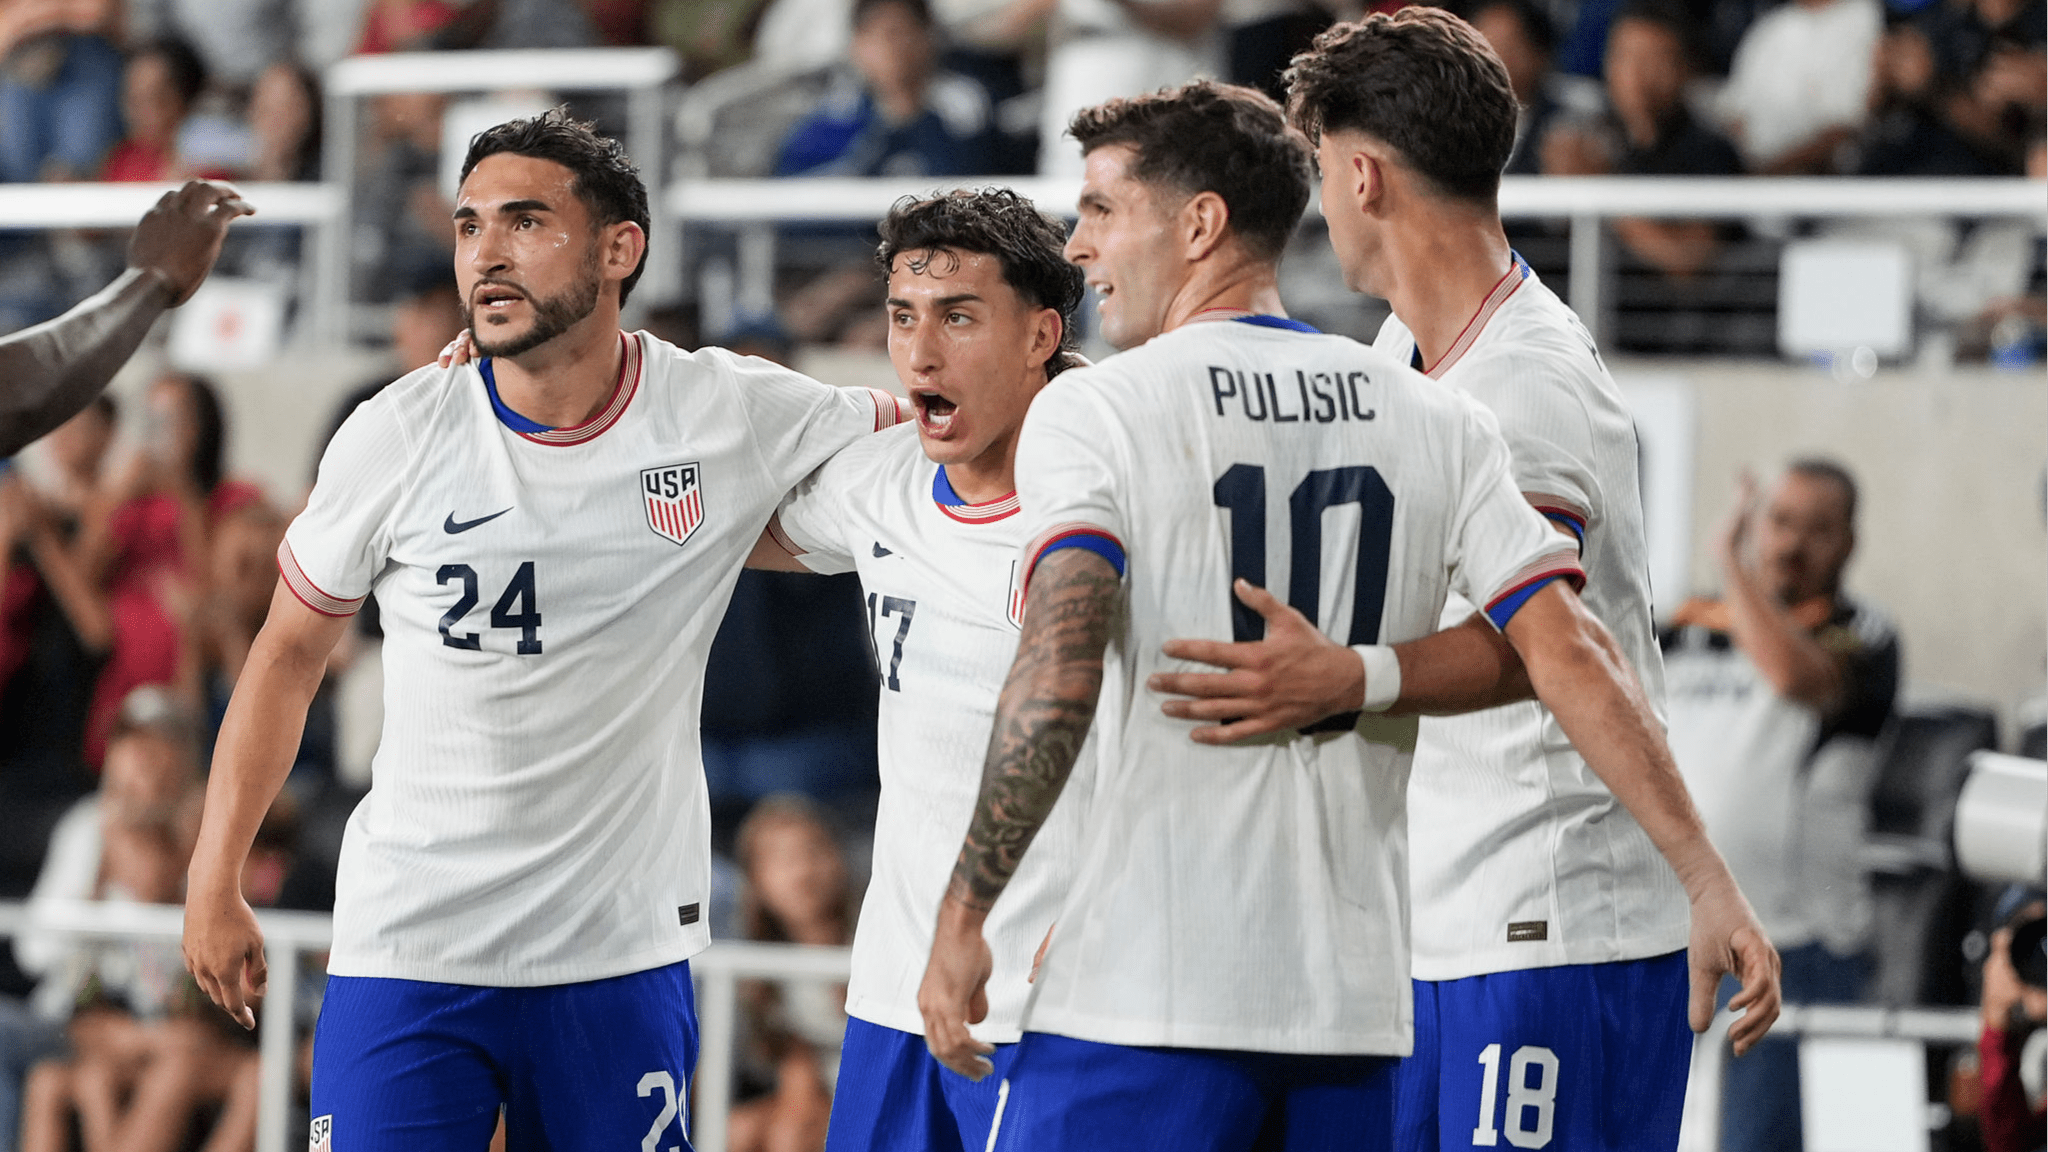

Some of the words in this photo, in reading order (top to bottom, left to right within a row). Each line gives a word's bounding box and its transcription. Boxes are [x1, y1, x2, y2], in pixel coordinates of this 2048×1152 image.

[1208, 366, 1376, 423] PULISIC
[645, 467, 696, 499] USA
[435, 561, 543, 654] 24
[867, 592, 917, 692] 17
[1213, 463, 1395, 735] 10
[636, 1070, 690, 1152] 2
[1472, 1043, 1560, 1150] 18
